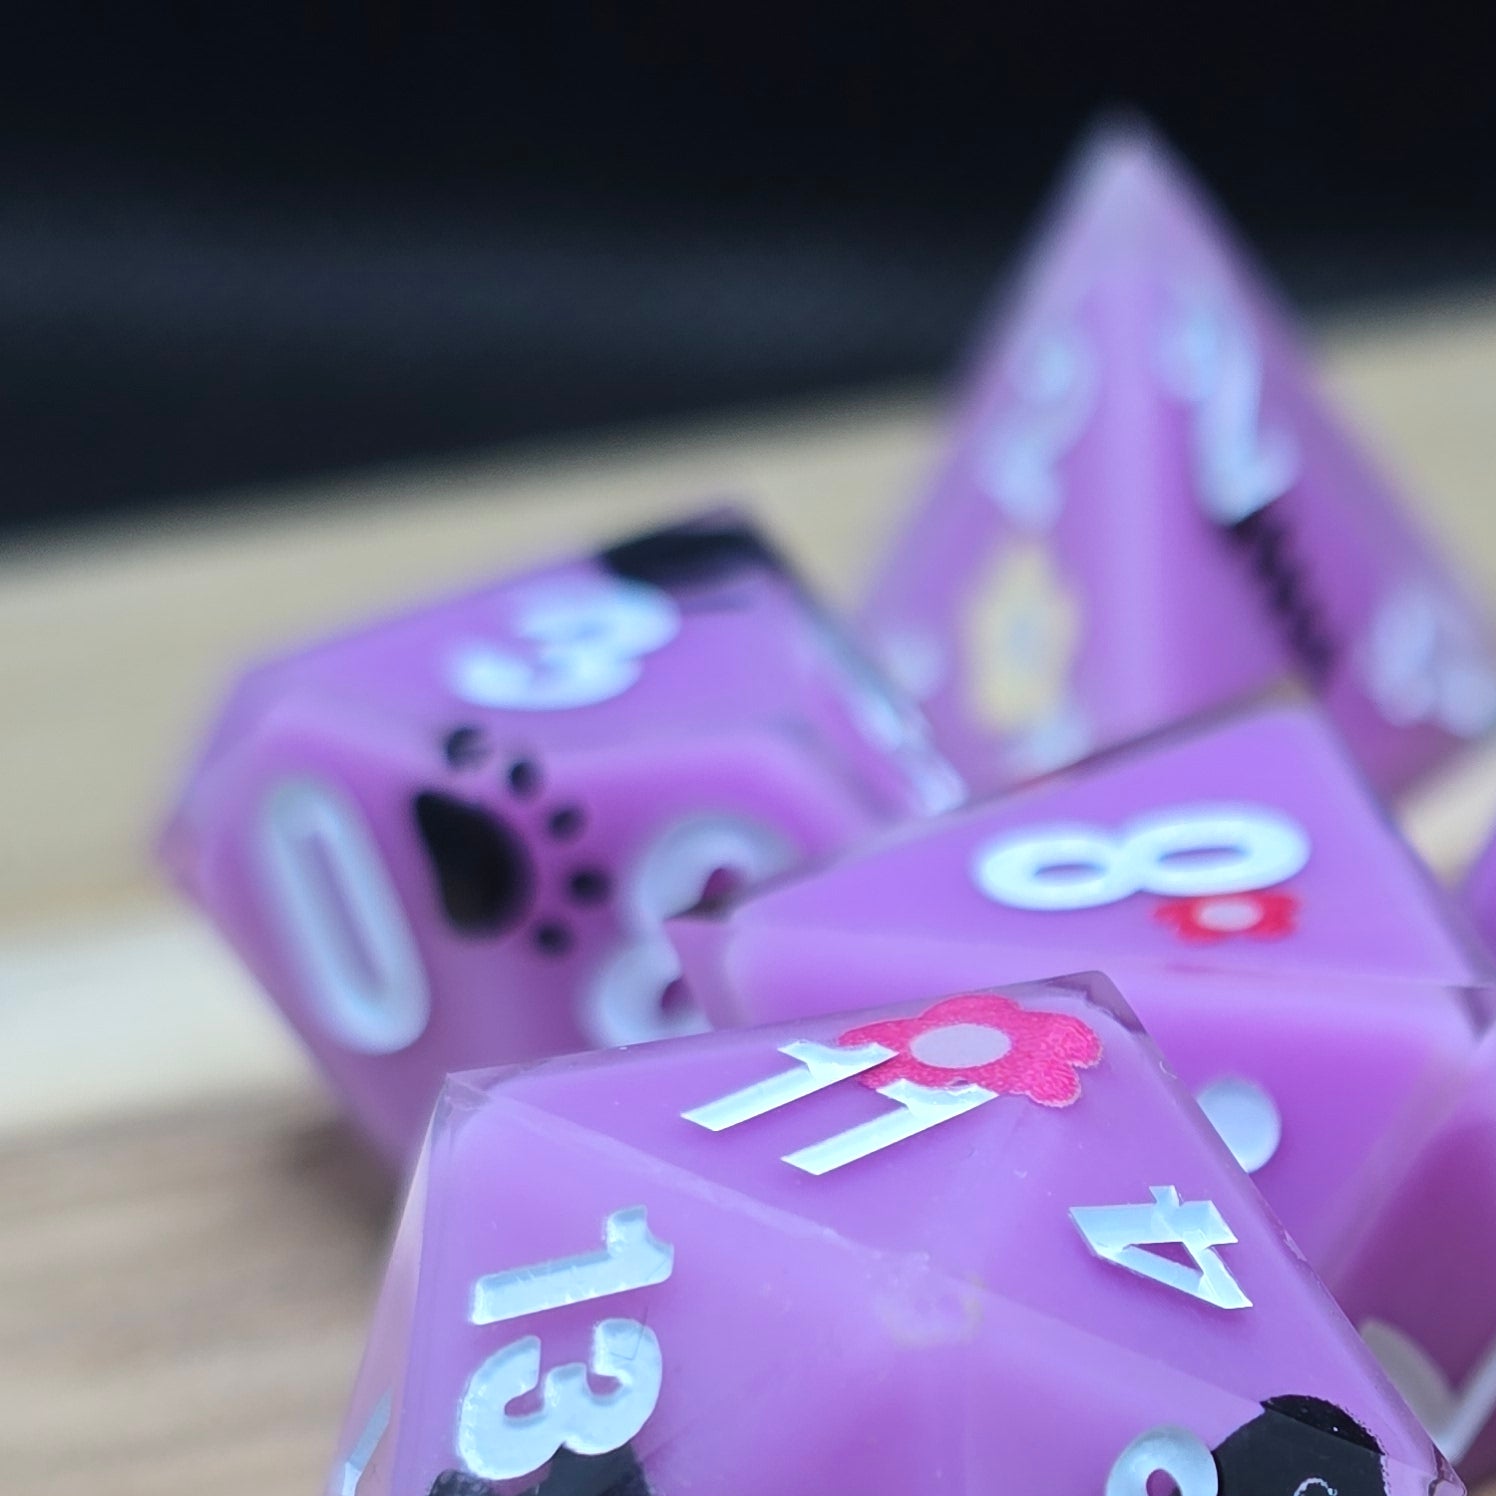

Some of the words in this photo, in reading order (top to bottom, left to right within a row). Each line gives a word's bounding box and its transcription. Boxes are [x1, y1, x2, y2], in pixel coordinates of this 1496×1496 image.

[978, 806, 1310, 911] 8
[680, 1040, 998, 1174] 11
[1069, 1185, 1253, 1310] 4
[456, 1206, 674, 1481] 13
